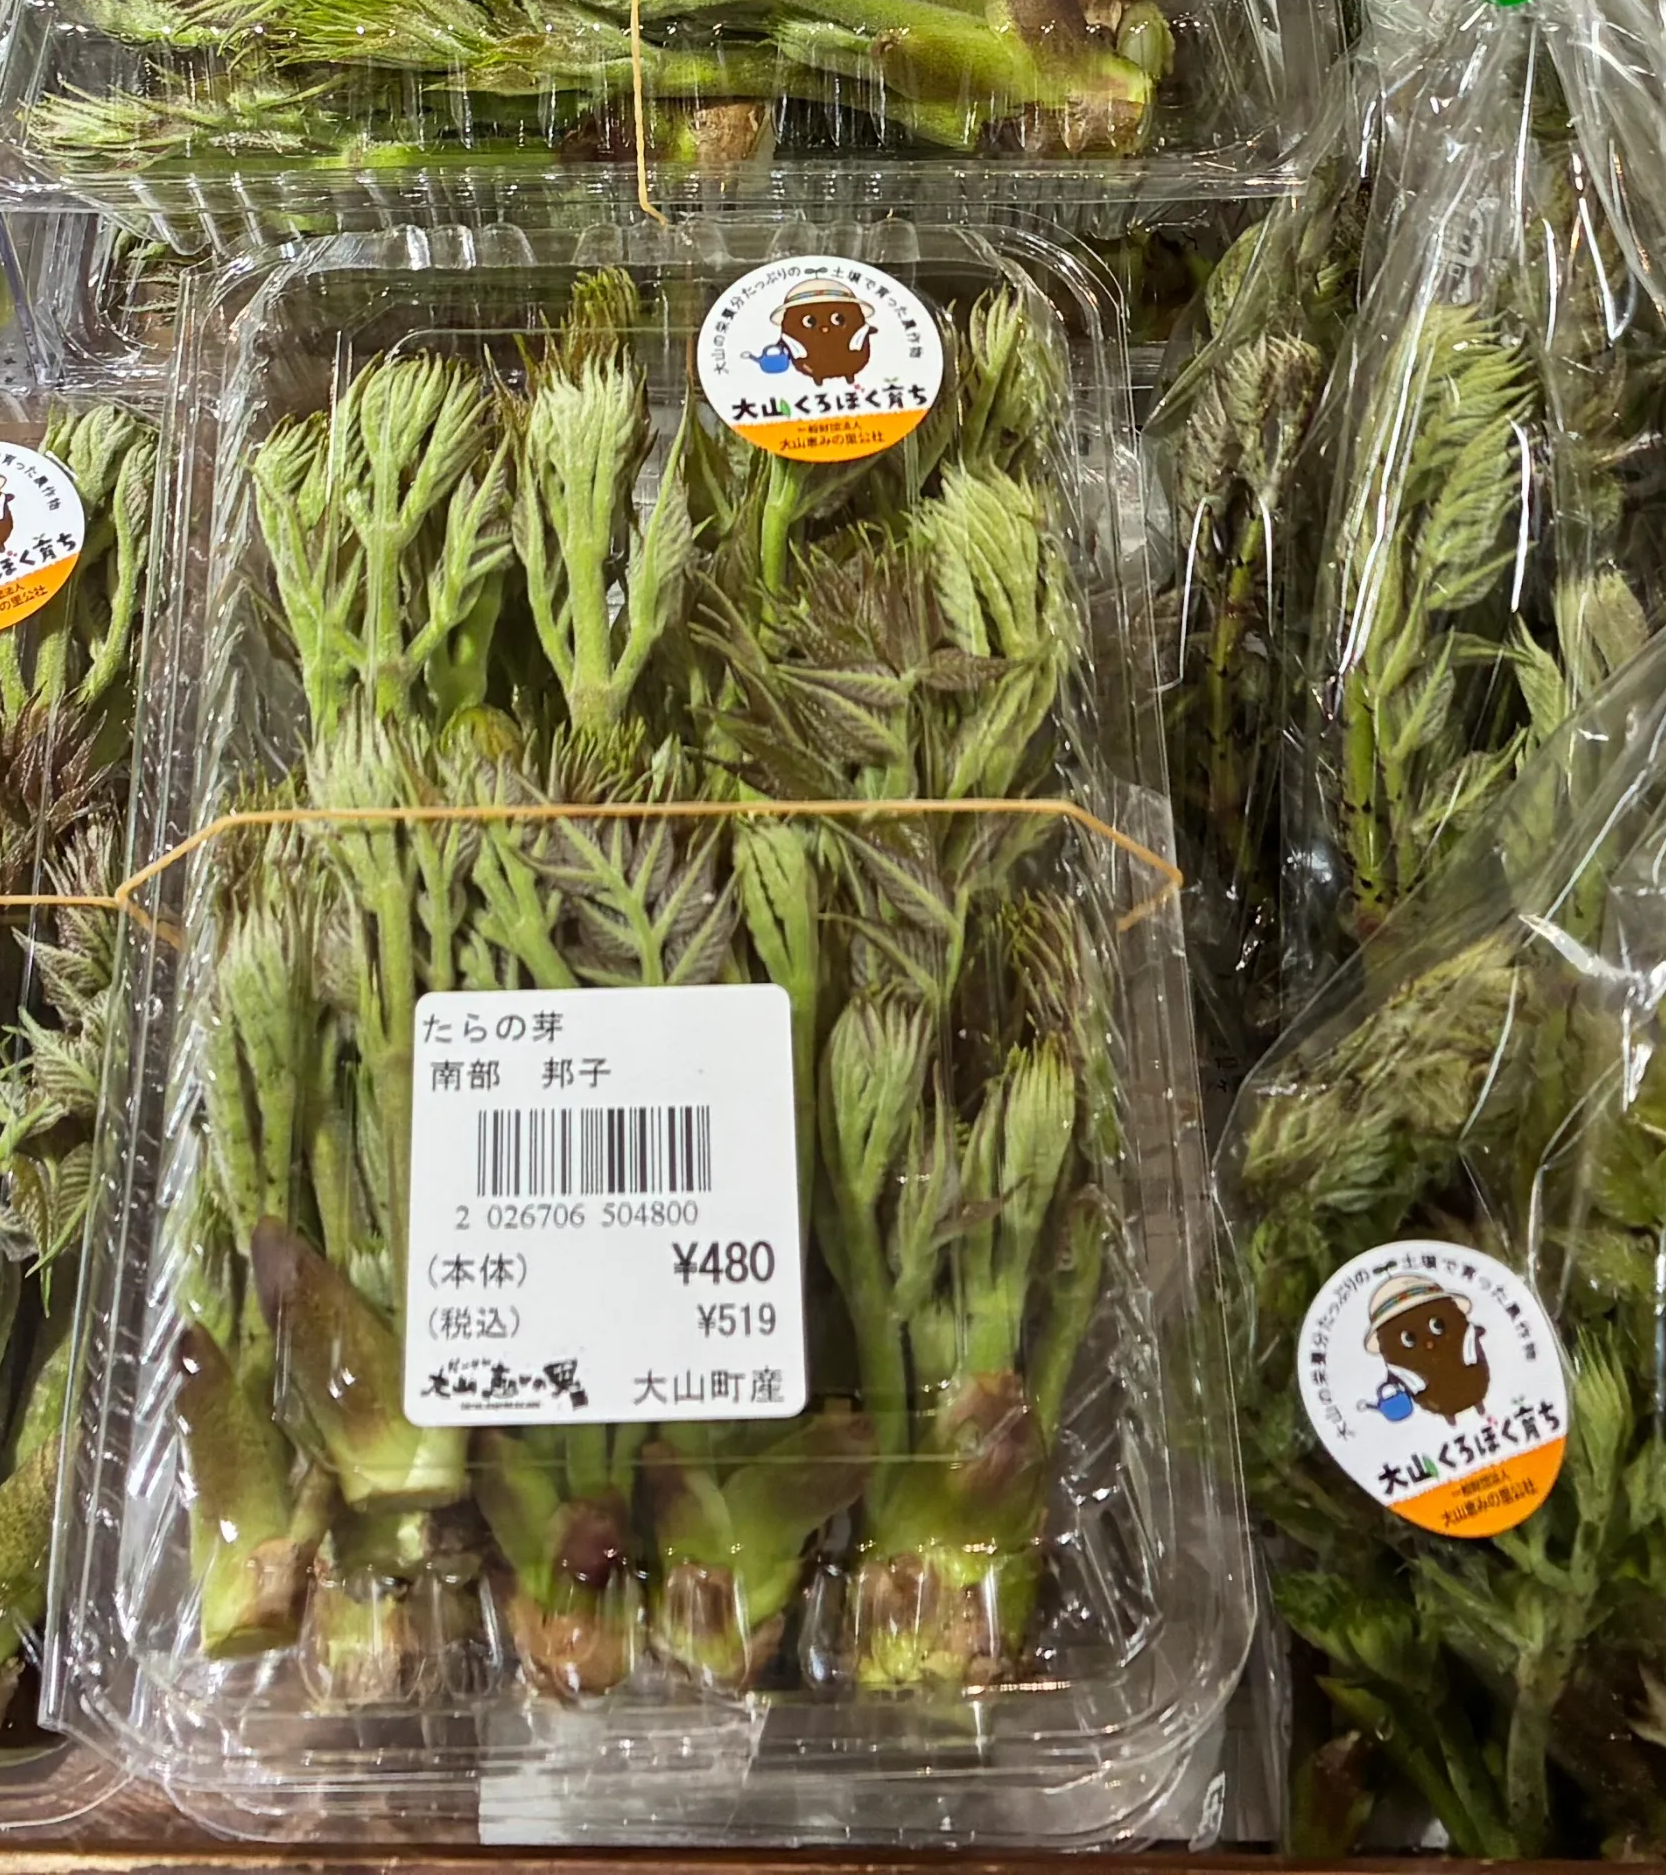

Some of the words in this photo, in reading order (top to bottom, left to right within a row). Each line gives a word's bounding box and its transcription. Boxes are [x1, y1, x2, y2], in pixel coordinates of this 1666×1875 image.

[732, 377, 928, 420] 大山くろぼく育ち
[422, 1009, 564, 1046] たらの芽
[430, 1059, 501, 1092] 南部
[542, 1056, 611, 1089] 邦子
[487, 1201, 586, 1230] 026706
[600, 1199, 699, 1228] 504800
[427, 1252, 528, 1290] (本体)
[671, 1239, 776, 1286] ¥480
[427, 1305, 521, 1340] (税込)
[696, 1302, 777, 1338] ¥519
[633, 1366, 785, 1407] 大山町産
[1378, 1396, 1562, 1495] 大山くろぼく育ち
